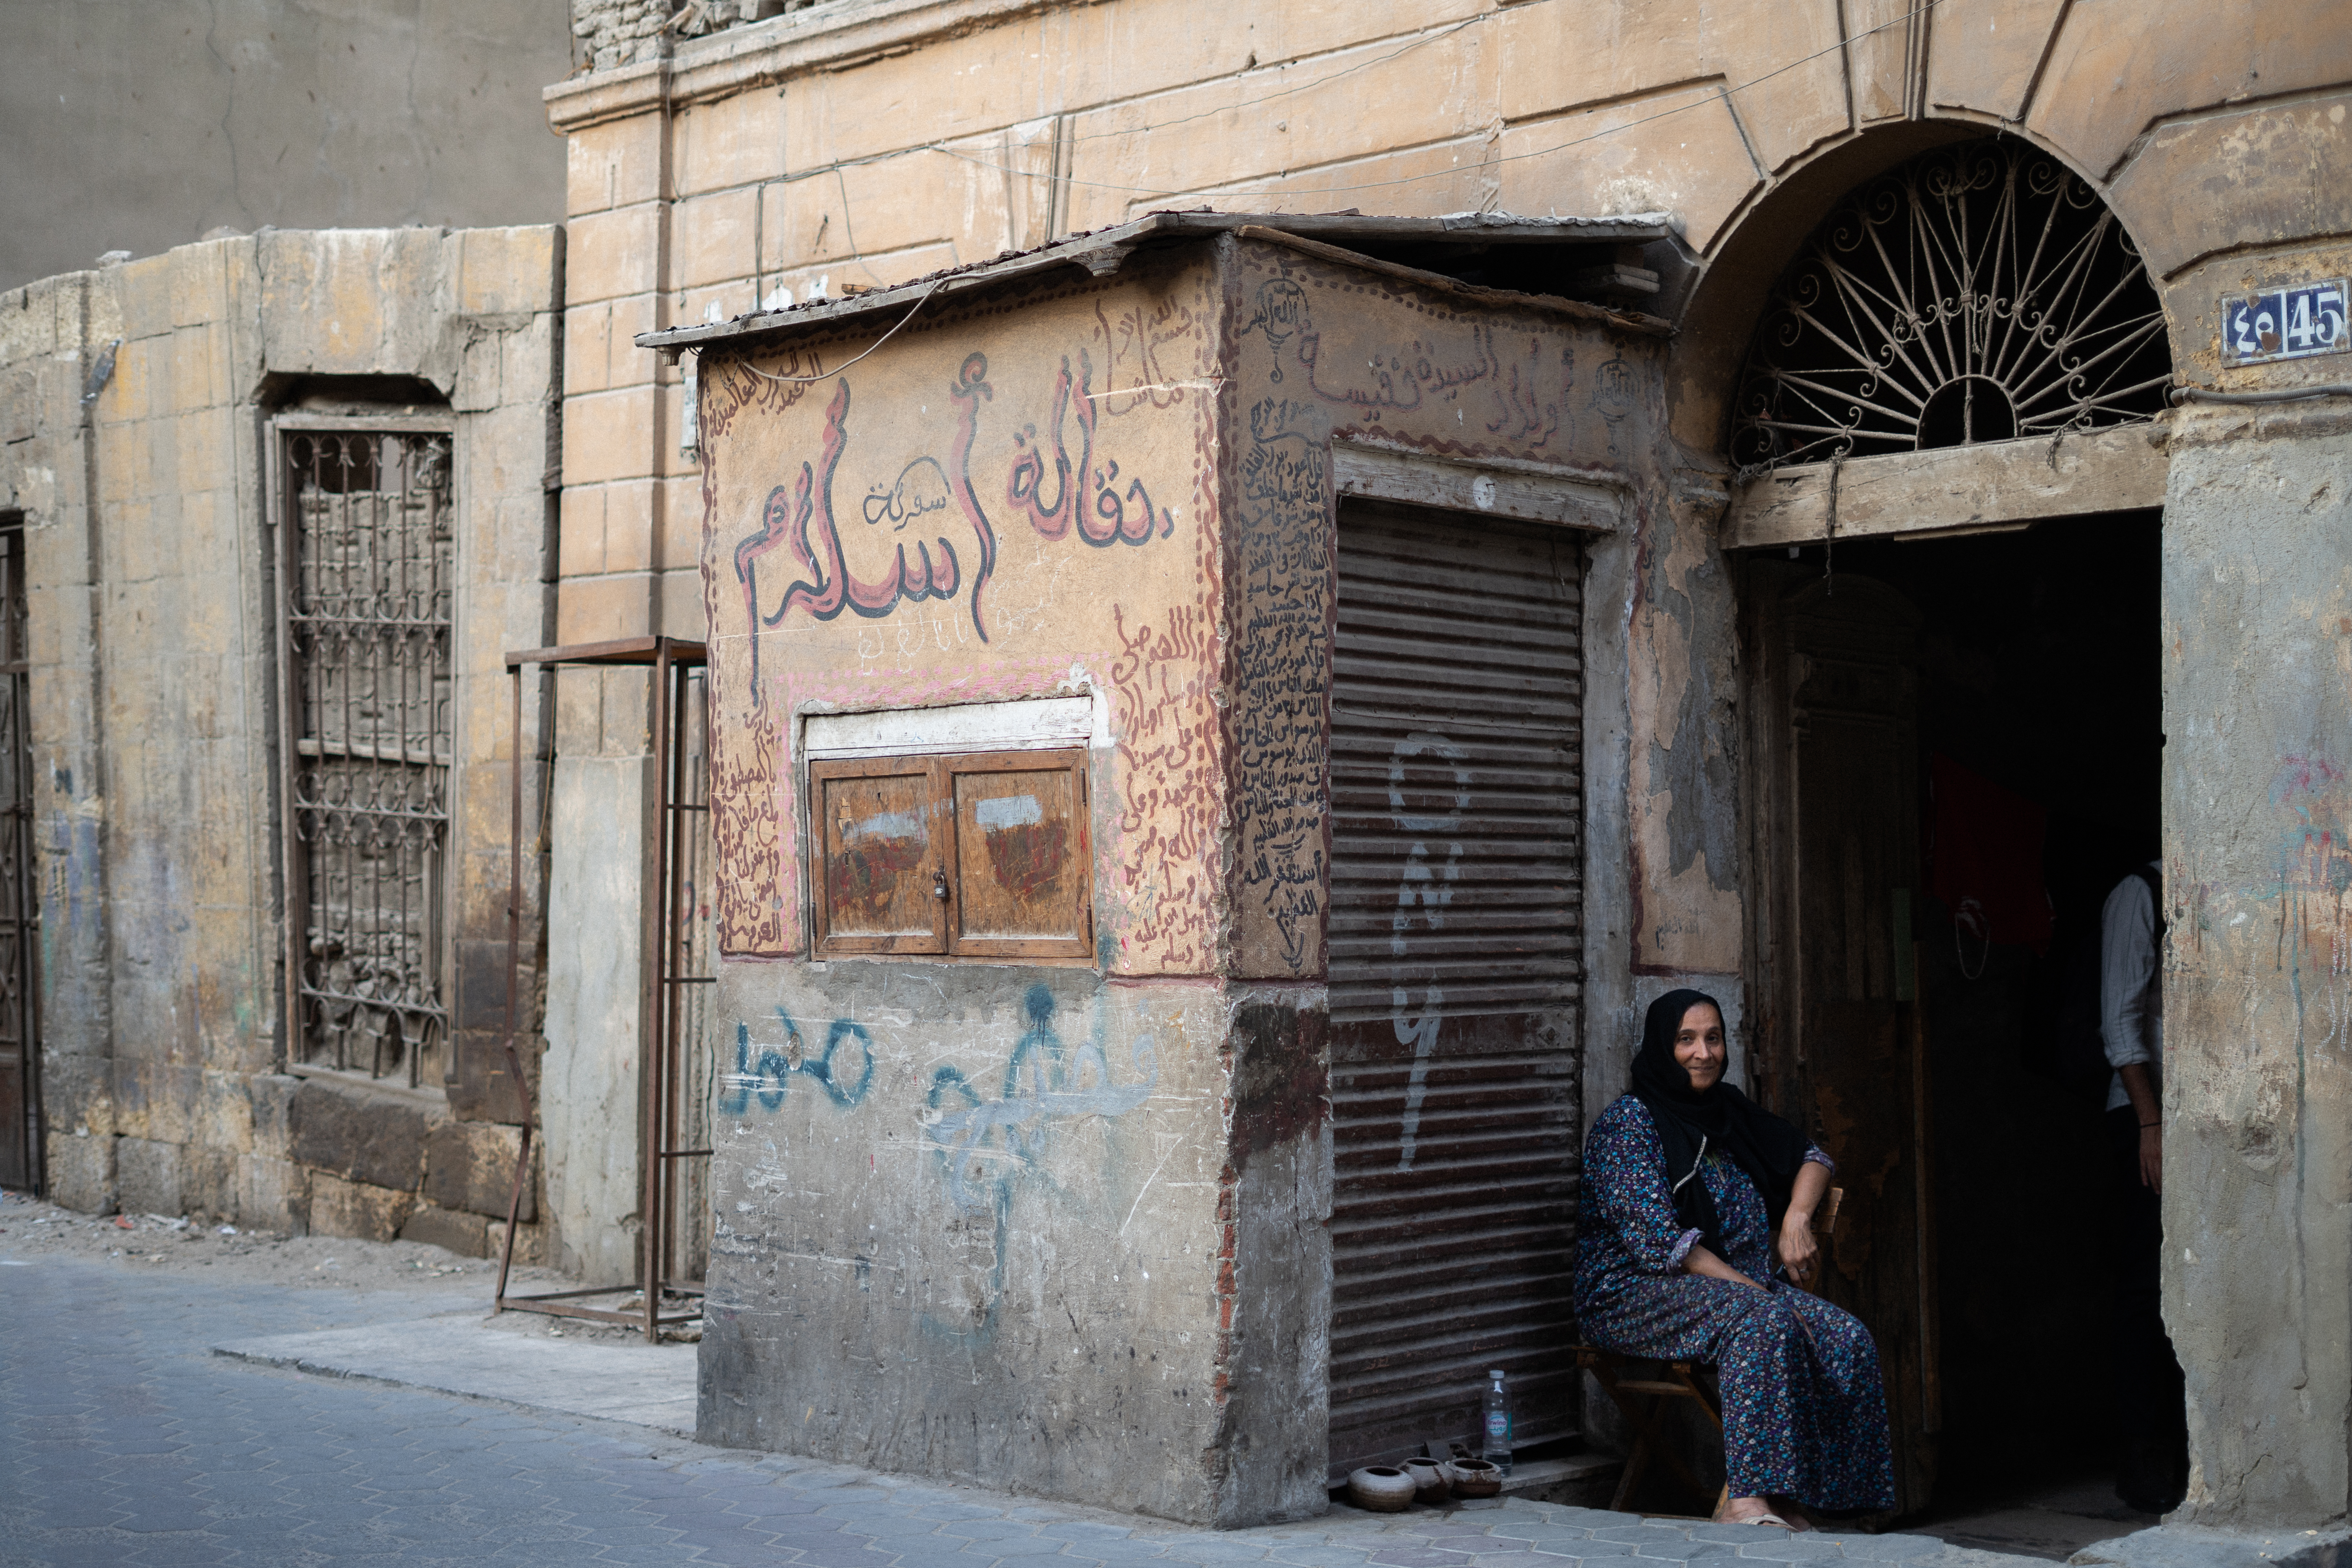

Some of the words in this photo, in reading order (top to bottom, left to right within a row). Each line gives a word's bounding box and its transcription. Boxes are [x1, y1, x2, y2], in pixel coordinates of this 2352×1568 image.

[2234, 306, 2274, 352] ٤٥
[2288, 290, 2344, 347] 45
[1297, 319, 1423, 422] نفيسة
[1413, 324, 1499, 402] السيدة
[776, 352, 824, 415] الحمد
[1006, 348, 1174, 549] بقالة
[1239, 443, 1269, 489] الفلق
[1246, 472, 1278, 501] خلق
[1278, 475, 1288, 503] ما
[1286, 481, 1302, 510] شر
[1303, 489, 1320, 505] من
[1299, 509, 1323, 529] ومن
[1301, 576, 1325, 595] ومن
[1268, 598, 1305, 613] حسد
[1278, 613, 1296, 626] الله
[1247, 606, 1277, 643] العظيم
[1266, 624, 1295, 657] الرحمن
[1295, 623, 1309, 643] الله
[1309, 625, 1328, 650] بسم
[1145, 605, 1197, 691] اللهم
[1238, 636, 1266, 673] الرحيم
[1239, 657, 1270, 691] الناس
[1272, 675, 1302, 695] الناس
[1156, 664, 1196, 727] وسلم
[1265, 702, 1283, 720] من
[1293, 696, 1322, 718] الناس
[1114, 743, 1165, 776] سيدنا
[1156, 769, 1198, 810] محمد
[1242, 766, 1275, 792] الناس
[1277, 771, 1305, 788] صدور
[757, 784, 779, 848] بلغ
[1280, 816, 1293, 835] الله
[1253, 818, 1280, 857] العظيم
[1244, 852, 1272, 885] الله
[1155, 860, 1196, 926] وسلم
[1134, 918, 1158, 953] عليه
[1161, 932, 1193, 969] وسلم
